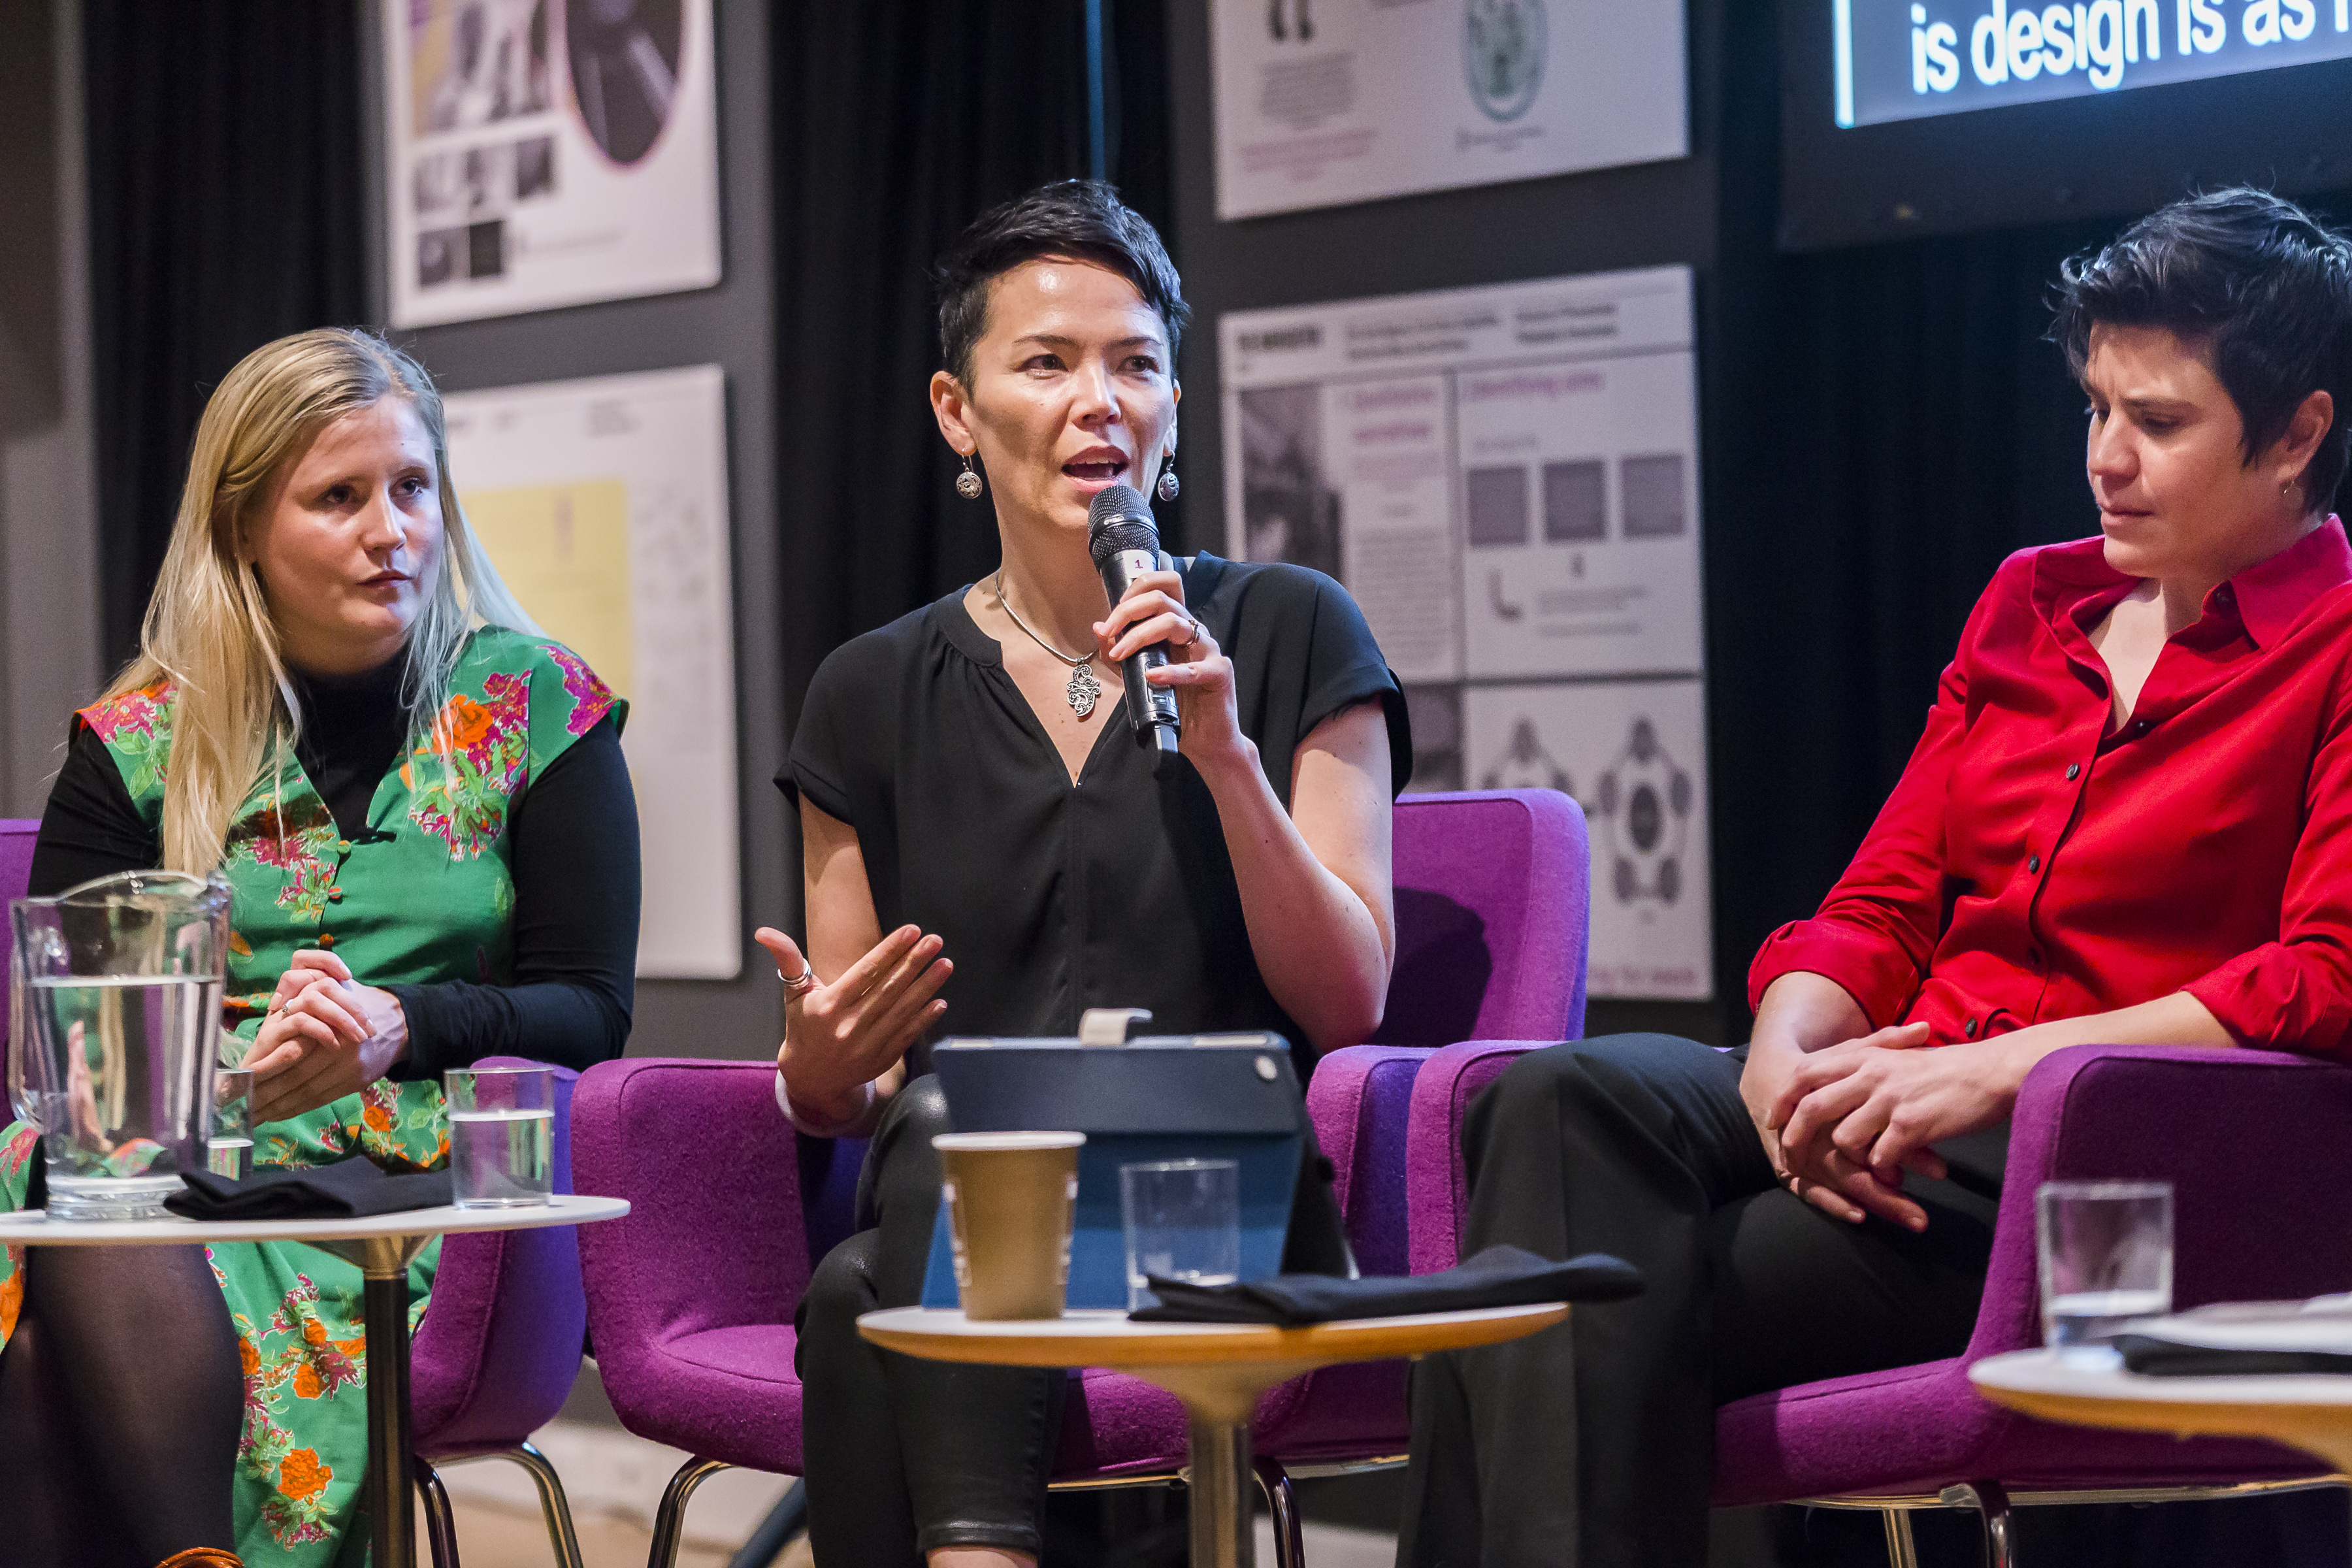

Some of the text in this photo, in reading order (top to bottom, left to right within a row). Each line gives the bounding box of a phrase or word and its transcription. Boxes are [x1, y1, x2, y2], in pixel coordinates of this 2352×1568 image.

[1910, 2, 1959, 94] is
[1970, 0, 2161, 91] design
[2177, 0, 2227, 56] is
[2242, 0, 2317, 46] as
[1135, 559, 1143, 568] 1
